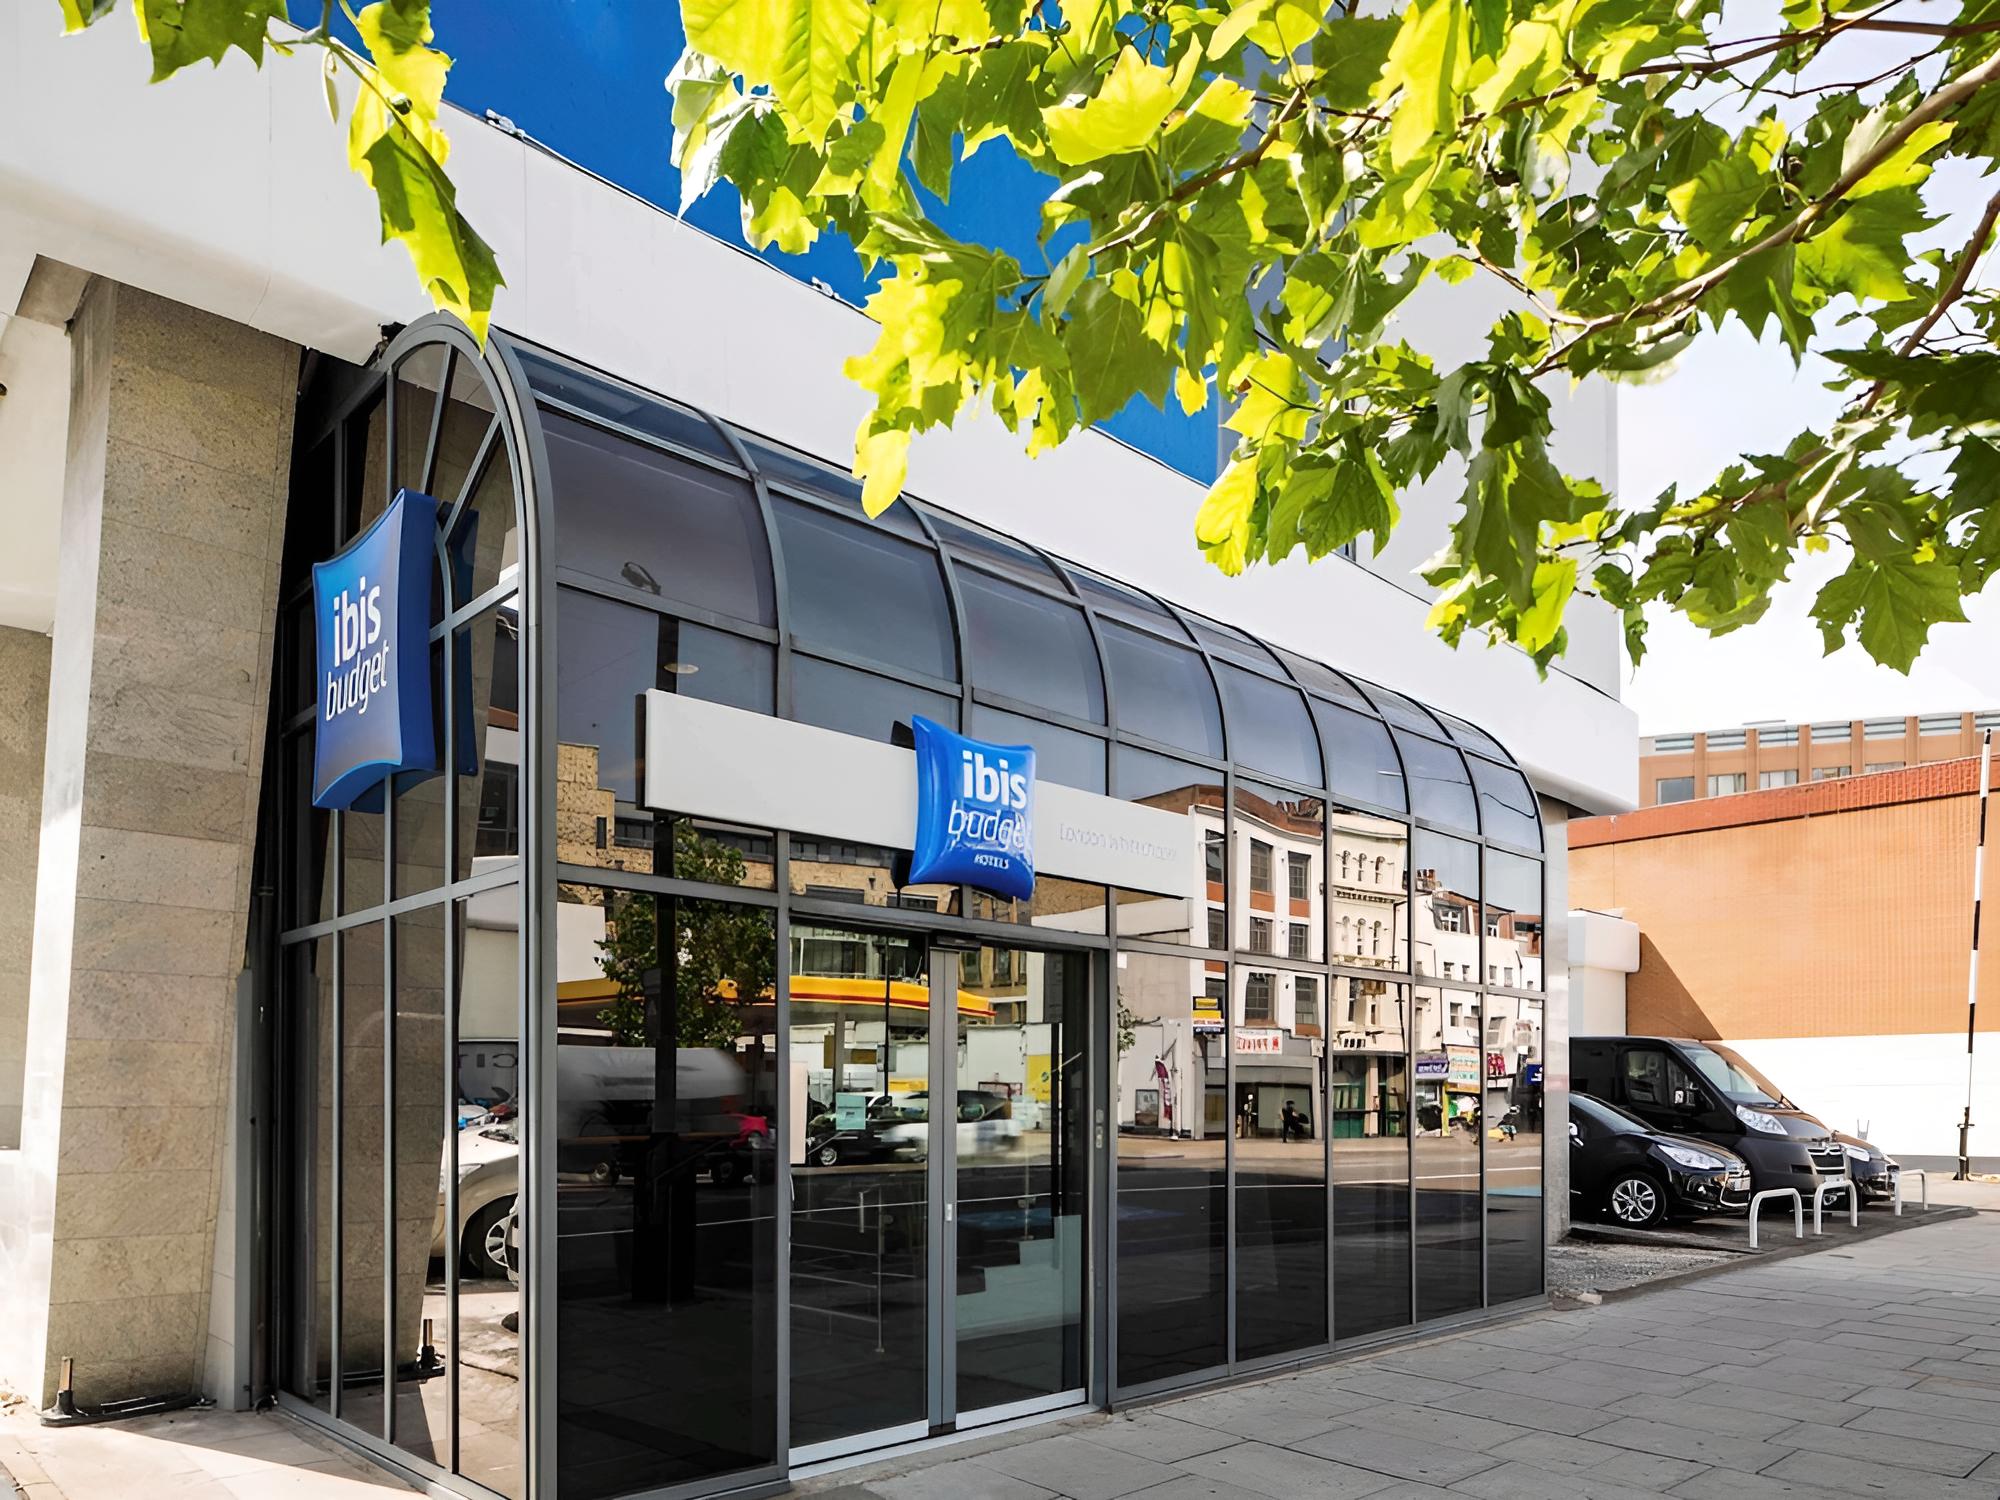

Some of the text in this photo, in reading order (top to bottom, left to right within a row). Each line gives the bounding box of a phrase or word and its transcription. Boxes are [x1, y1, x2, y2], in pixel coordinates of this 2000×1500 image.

[333, 576, 382, 667] ibis
[325, 639, 390, 721] budget
[962, 750, 1027, 809] ibis
[948, 799, 1028, 851] budge
